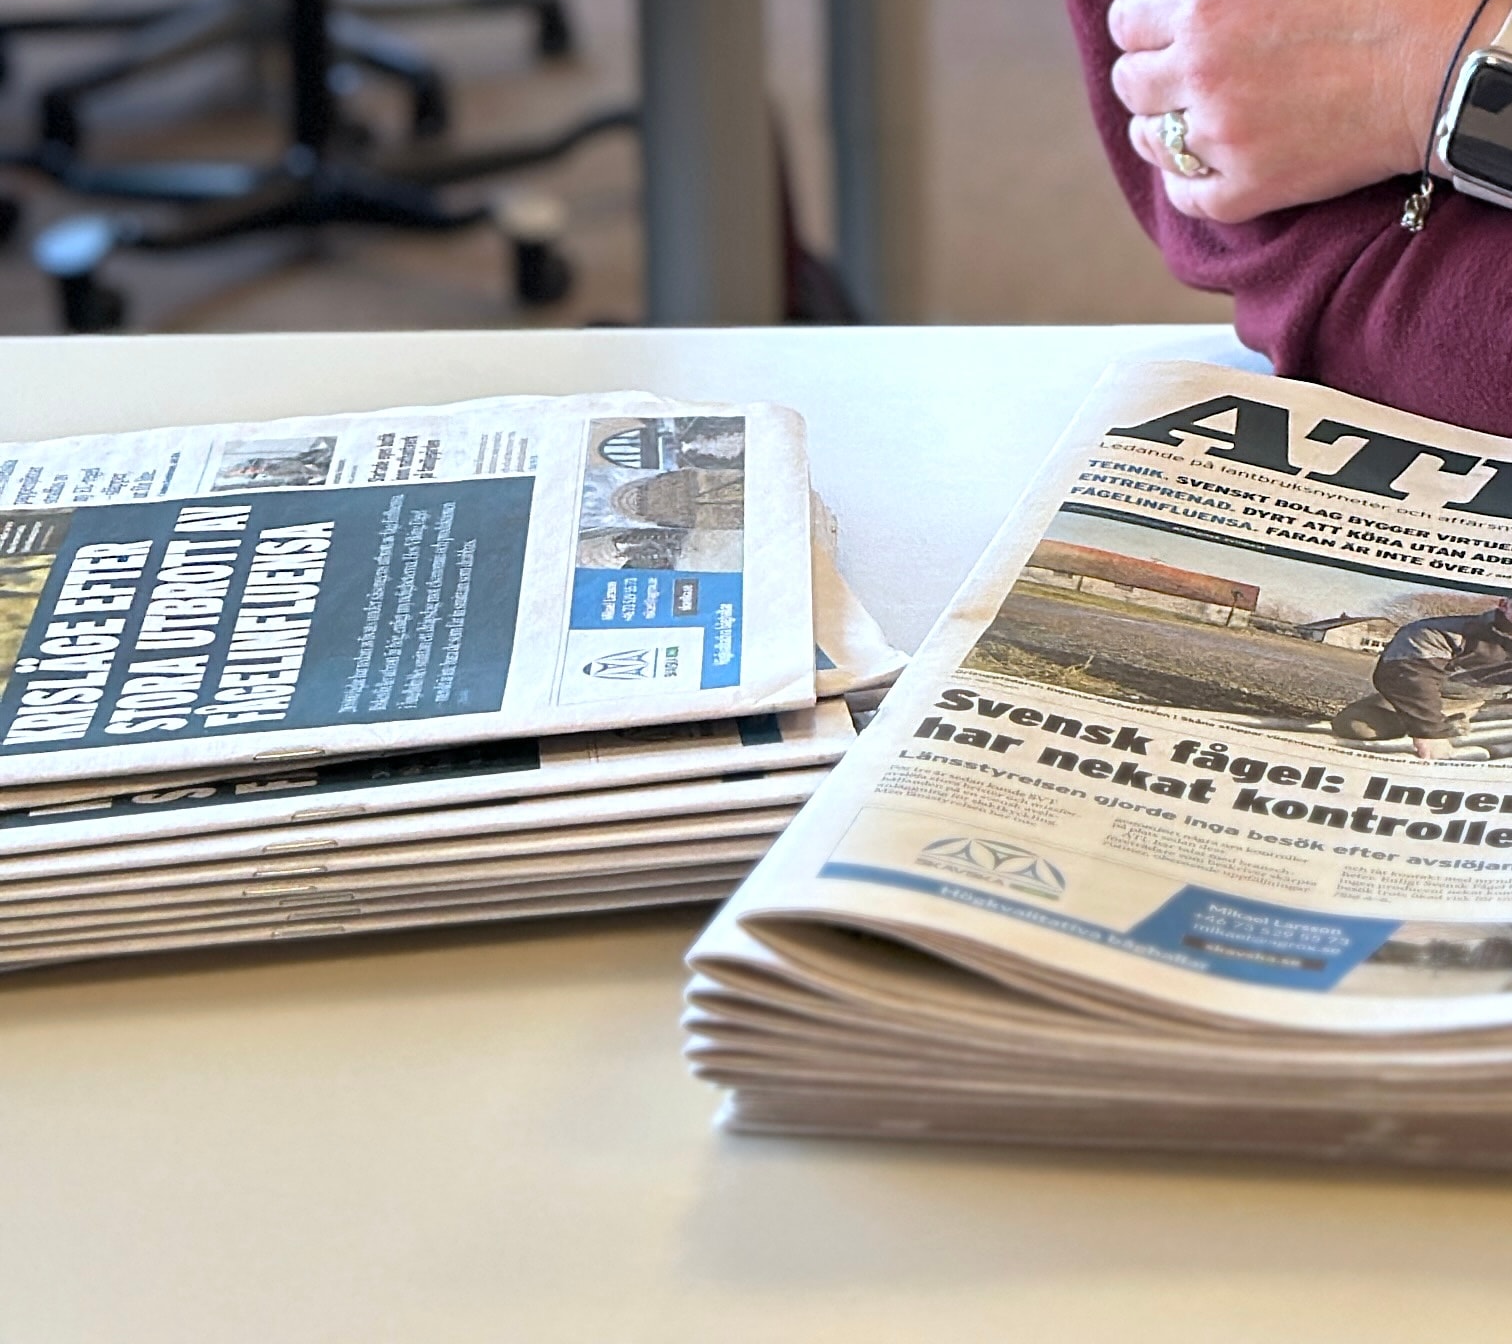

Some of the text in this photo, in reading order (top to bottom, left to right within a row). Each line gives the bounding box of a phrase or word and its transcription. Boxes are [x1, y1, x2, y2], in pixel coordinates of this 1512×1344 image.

[1078, 471, 1235, 513] ENTREPRENAD.
[1242, 506, 1297, 524] DYRT
[1302, 520, 1343, 535] ATT
[1347, 524, 1402, 547] KÖRA
[1410, 542, 1467, 560] UTAN
[1088, 459, 1169, 481] TEKNIK.
[1176, 475, 1269, 504] SVENSKT
[1274, 499, 1342, 521] BOLAG
[1348, 515, 1431, 539] BYGGER
[1100, 441, 1186, 463] Ledande
[1190, 457, 1215, 471] på
[1221, 463, 1393, 511] lantbruksnyheter
[1397, 506, 1432, 520] och
[1070, 485, 1259, 533] FÅGELINFLUENSA.
[1266, 526, 1337, 548] FARAN
[1341, 539, 1372, 555] ÄR
[1376, 550, 1425, 567] INTE
[1429, 559, 1485, 577] ÖVER
[53, 540, 153, 615] EFTER
[104, 505, 252, 735] STORA UTBROTT AV
[193, 521, 335, 728] FÅGELINFLUENSA
[2, 618, 126, 745] KRISLÄGE
[913, 716, 1025, 754] har
[1037, 746, 1217, 805] nekat
[934, 688, 1155, 756] Svensk
[1169, 738, 1345, 793] fågel:
[1328, 746, 1352, 757] med
[898, 749, 1087, 800] Länsstyrelsen
[1093, 794, 1178, 821] gjorde
[1247, 829, 1325, 852] besök
[1332, 843, 1401, 863] efter
[1210, 904, 1342, 936] Mikael Larsson
